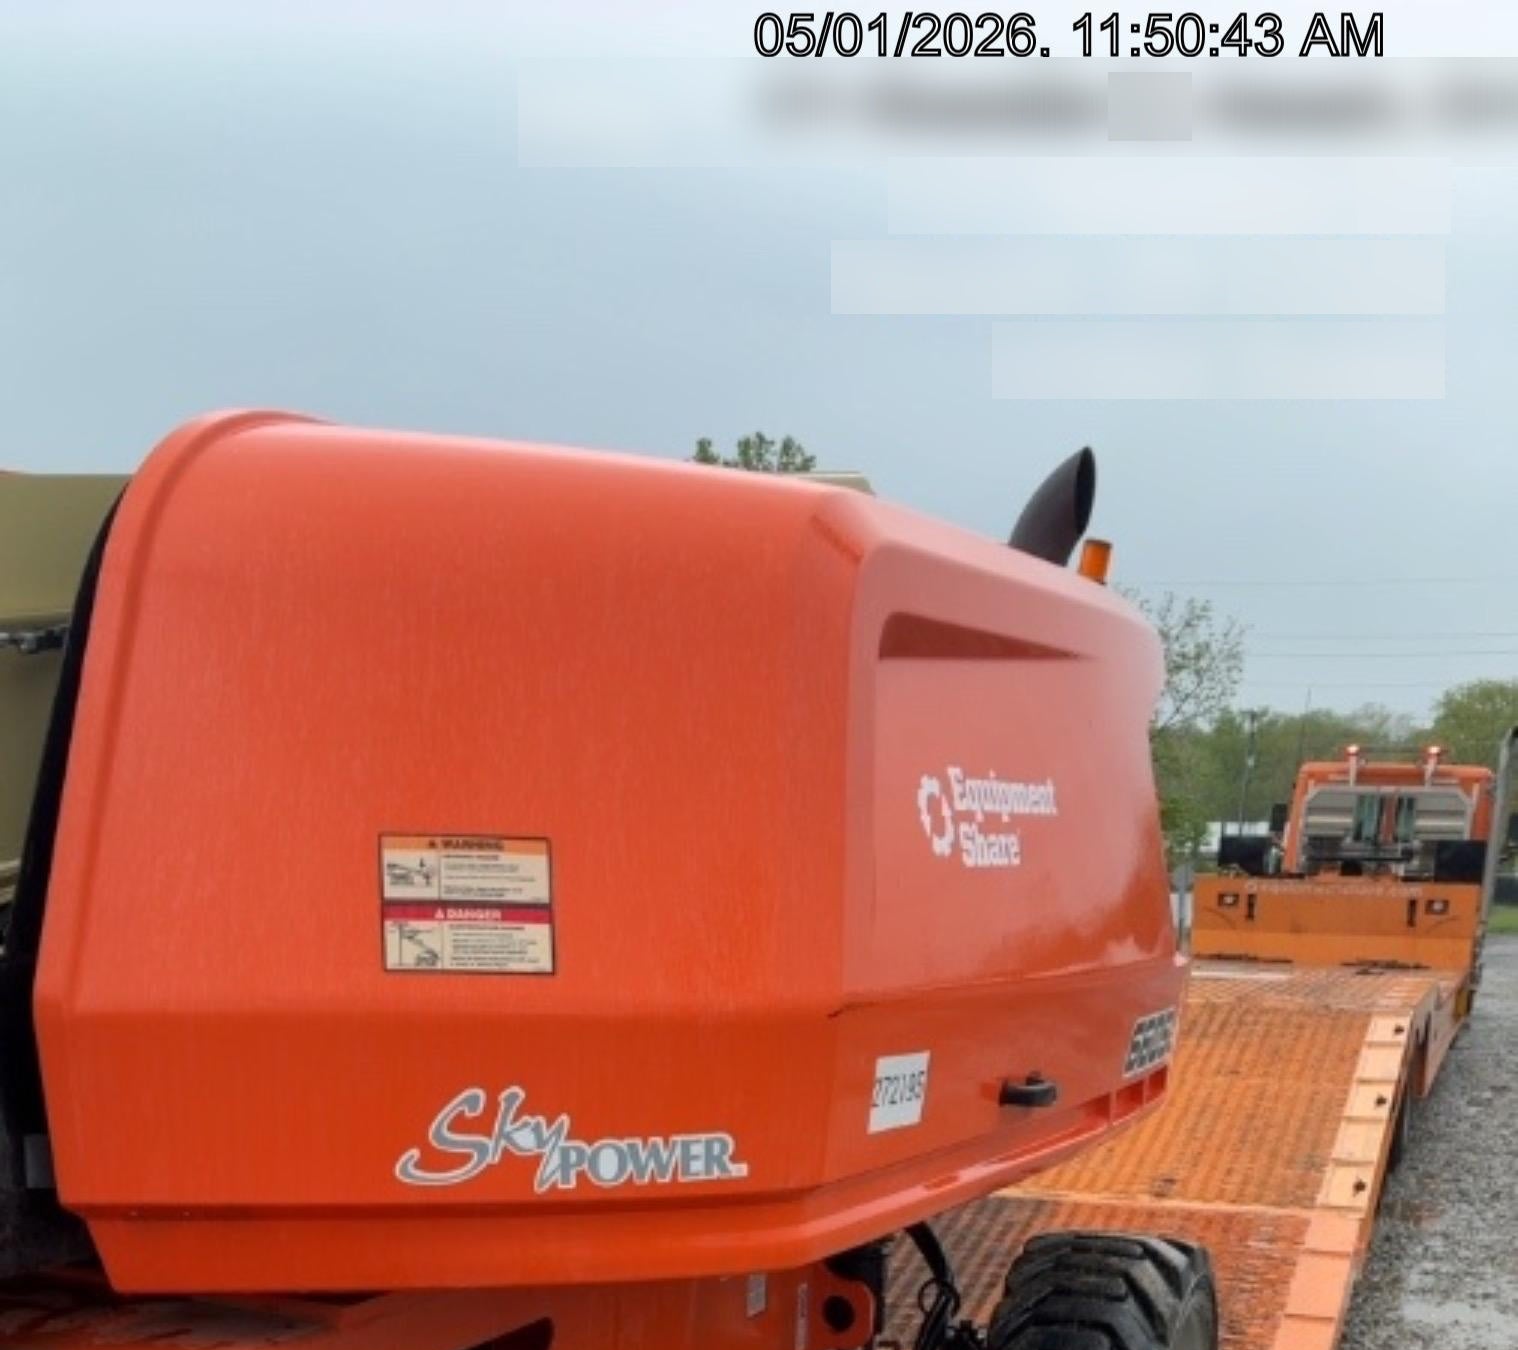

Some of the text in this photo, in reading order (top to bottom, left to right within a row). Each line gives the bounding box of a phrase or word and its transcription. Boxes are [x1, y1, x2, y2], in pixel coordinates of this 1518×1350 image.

[946, 765, 1058, 822] Equipment
[959, 821, 1022, 868] Share
[446, 907, 503, 921] DANGER
[871, 1069, 926, 1108] 272195
